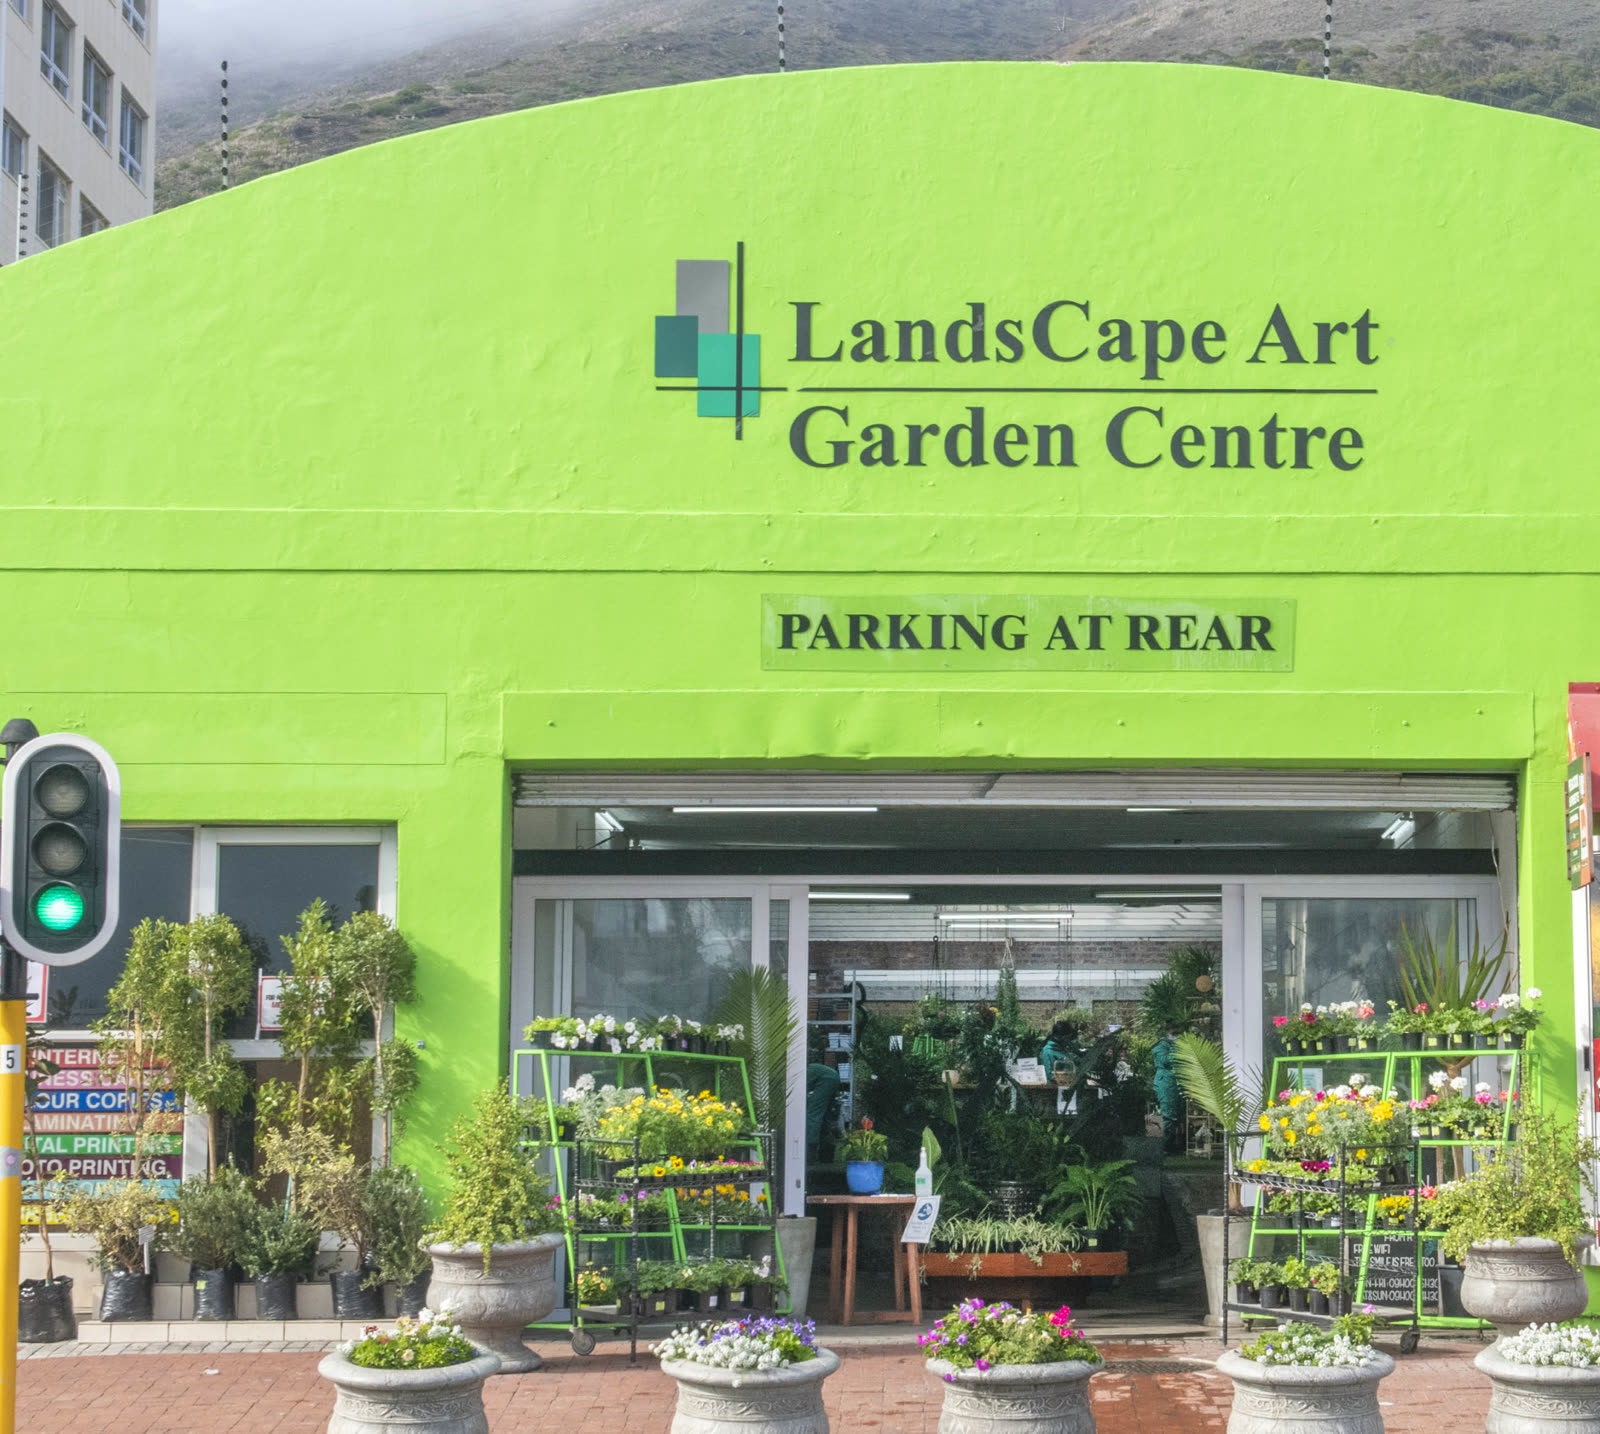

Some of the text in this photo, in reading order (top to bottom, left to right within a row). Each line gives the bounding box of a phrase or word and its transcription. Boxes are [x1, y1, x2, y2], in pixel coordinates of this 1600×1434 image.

[788, 300, 1380, 381] LandsCape Art
[789, 405, 1364, 471] Garden Centre
[778, 613, 1276, 652] PARKING AT REAR
[6, 1050, 16, 1069] 5
[32, 1092, 80, 1109] OUR
[24, 1114, 138, 1131] AMINATIN
[73, 1136, 171, 1153] PRINTNG
[22, 1158, 63, 1175] OTO
[1353, 1243, 1373, 1254] FRE
[1400, 1256, 1416, 1267] FRE
